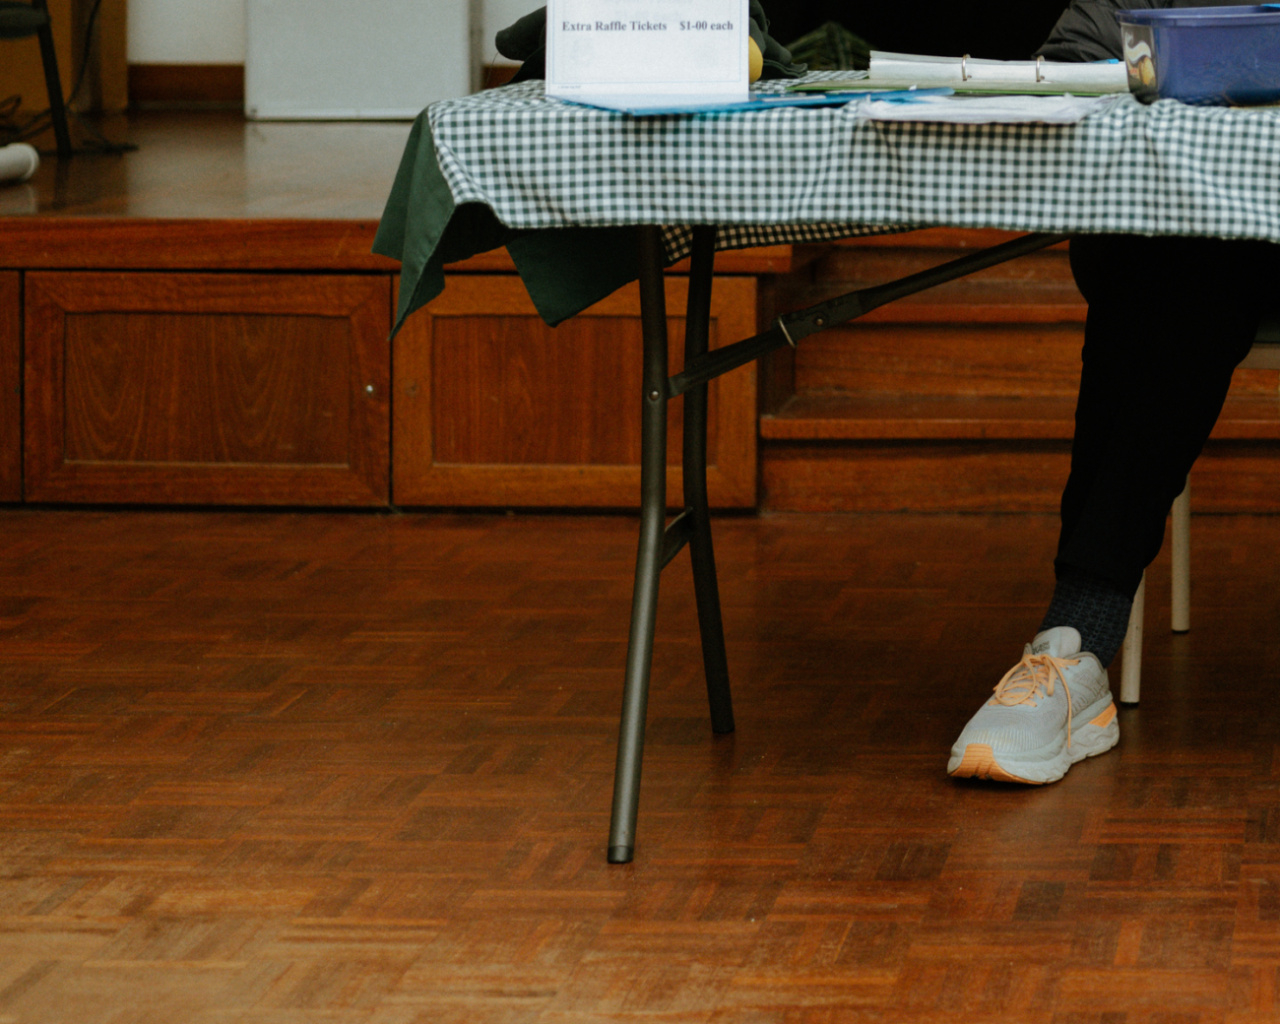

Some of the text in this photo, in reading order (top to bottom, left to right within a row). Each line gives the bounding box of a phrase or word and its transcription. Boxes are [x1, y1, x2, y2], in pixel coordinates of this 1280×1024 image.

[562, 20, 734, 31] Extra Raffle Tickets $1-00 each
